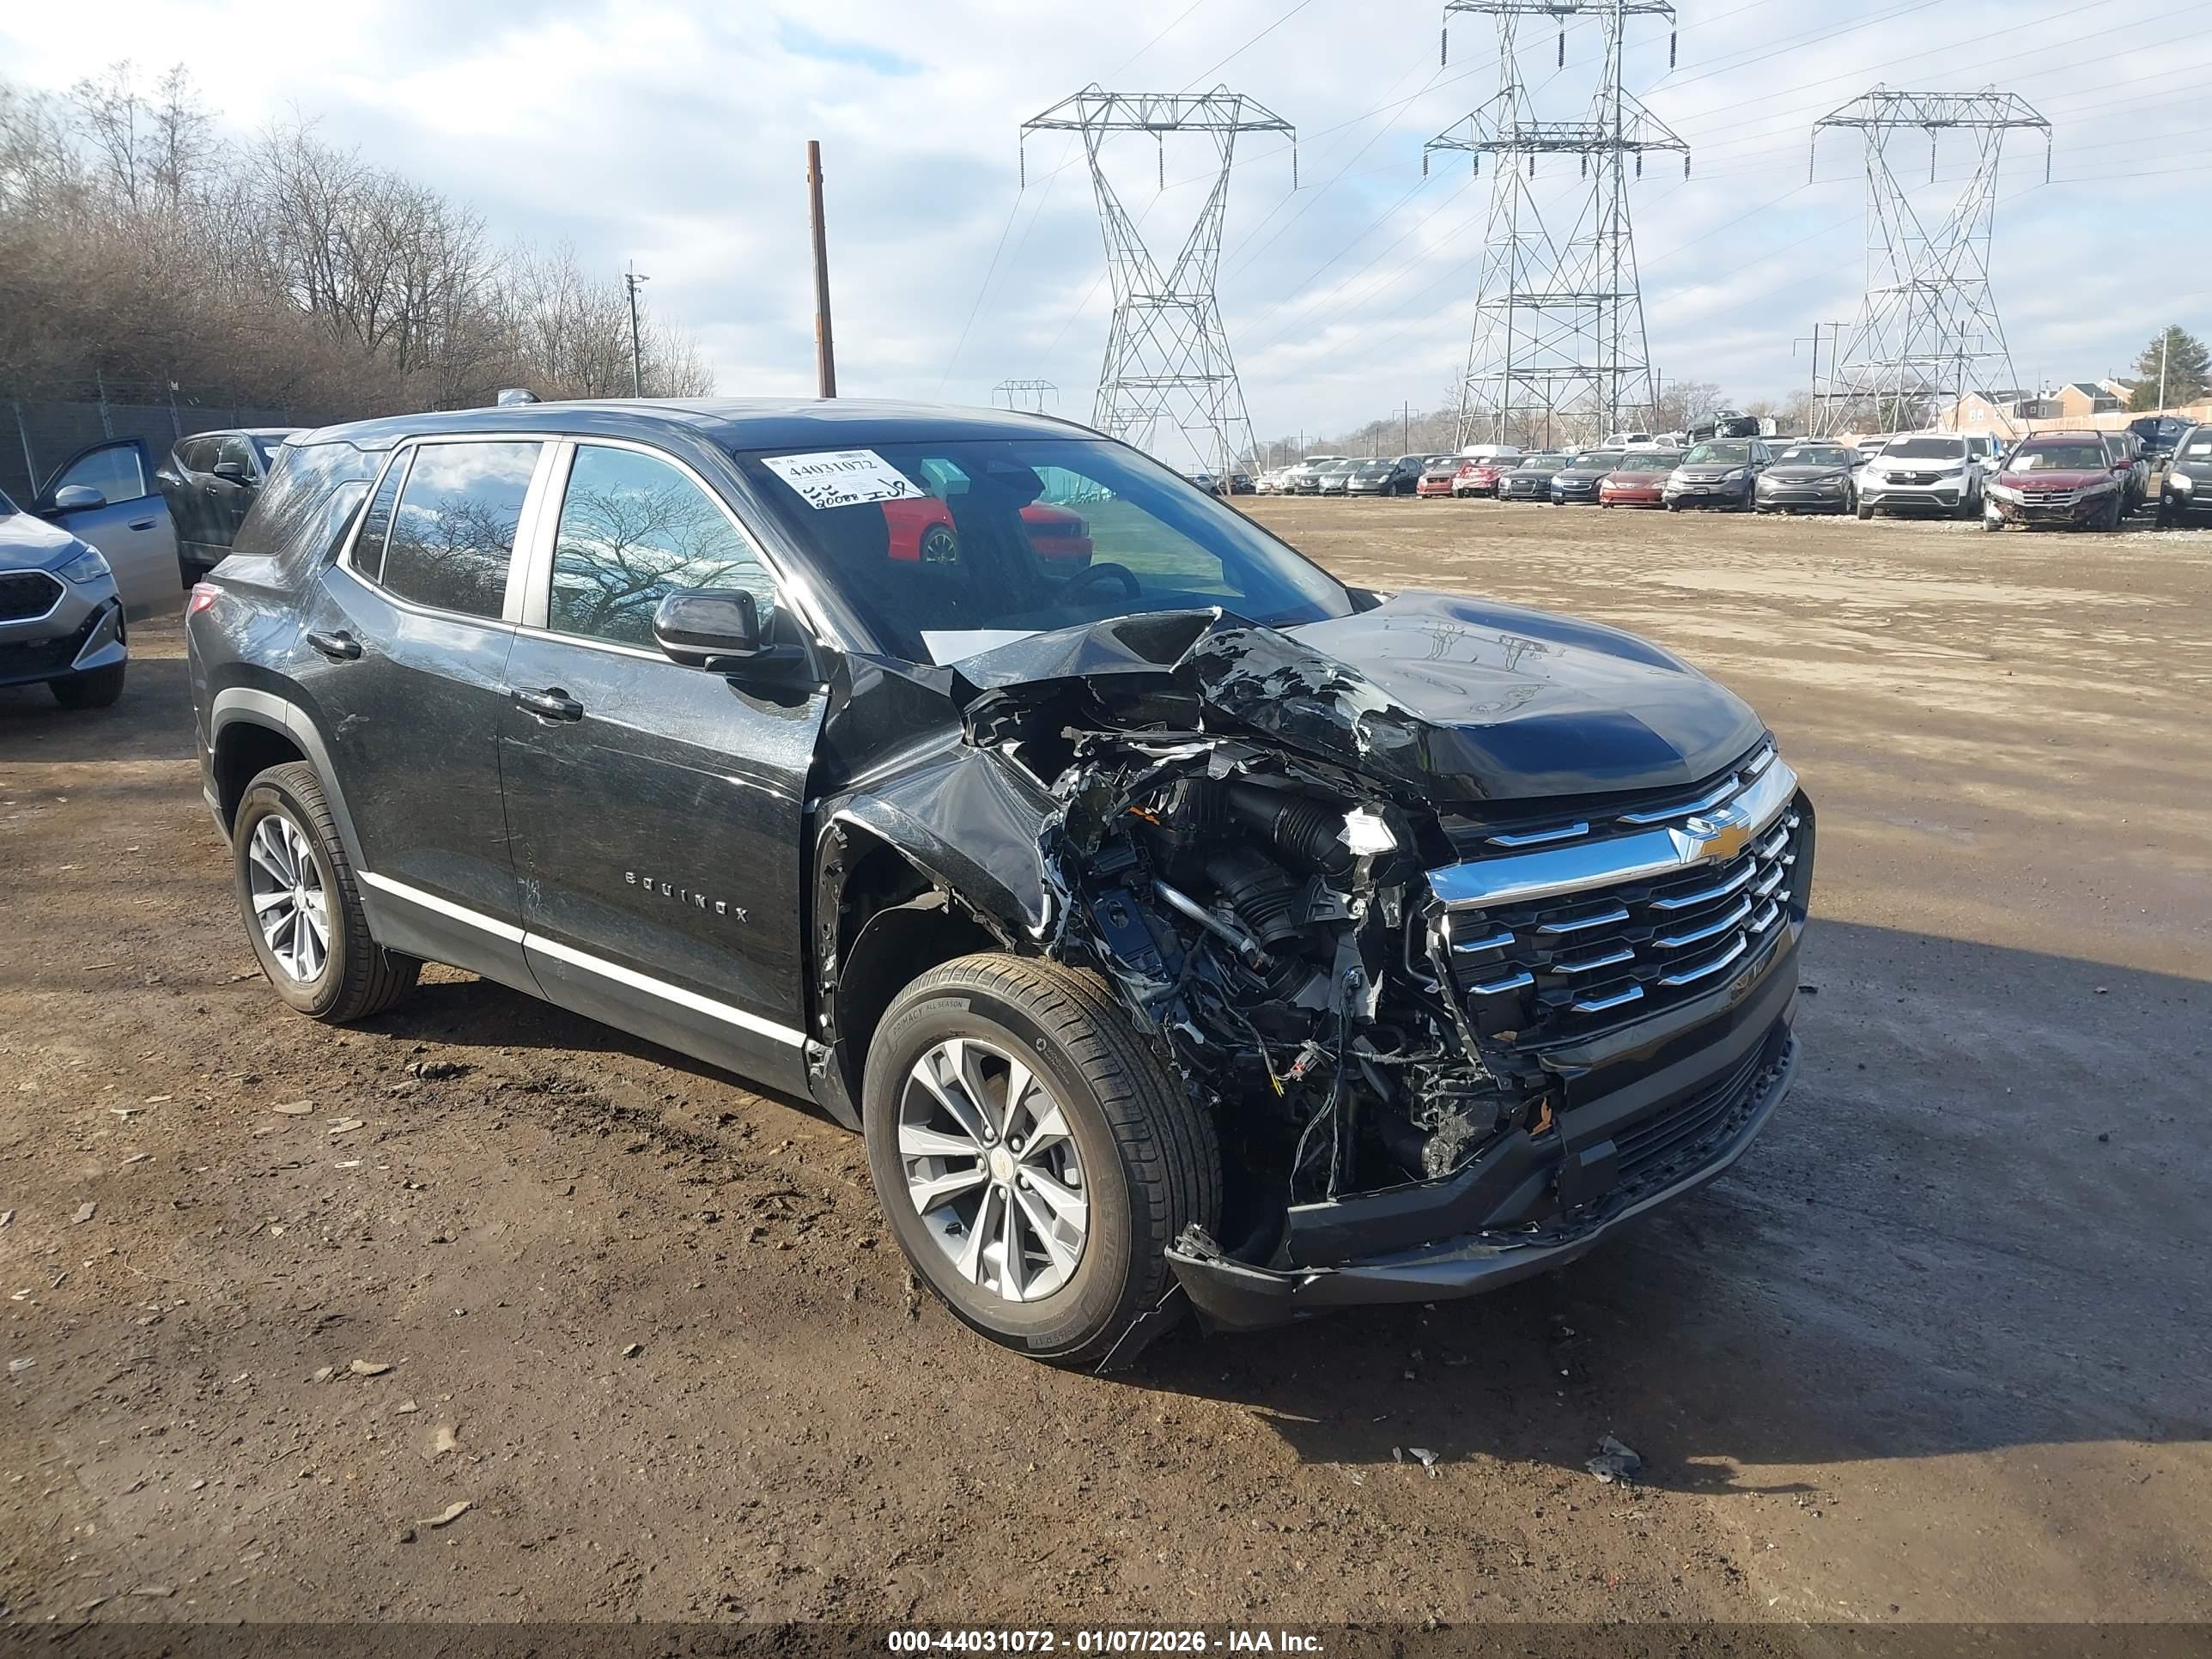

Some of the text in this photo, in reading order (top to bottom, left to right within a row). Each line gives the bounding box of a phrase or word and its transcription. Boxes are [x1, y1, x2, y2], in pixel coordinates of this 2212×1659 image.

[789, 460, 878, 477] 44031072
[625, 871, 749, 923] EQUINOX
[893, 1007, 923, 1036] PRIMACY
